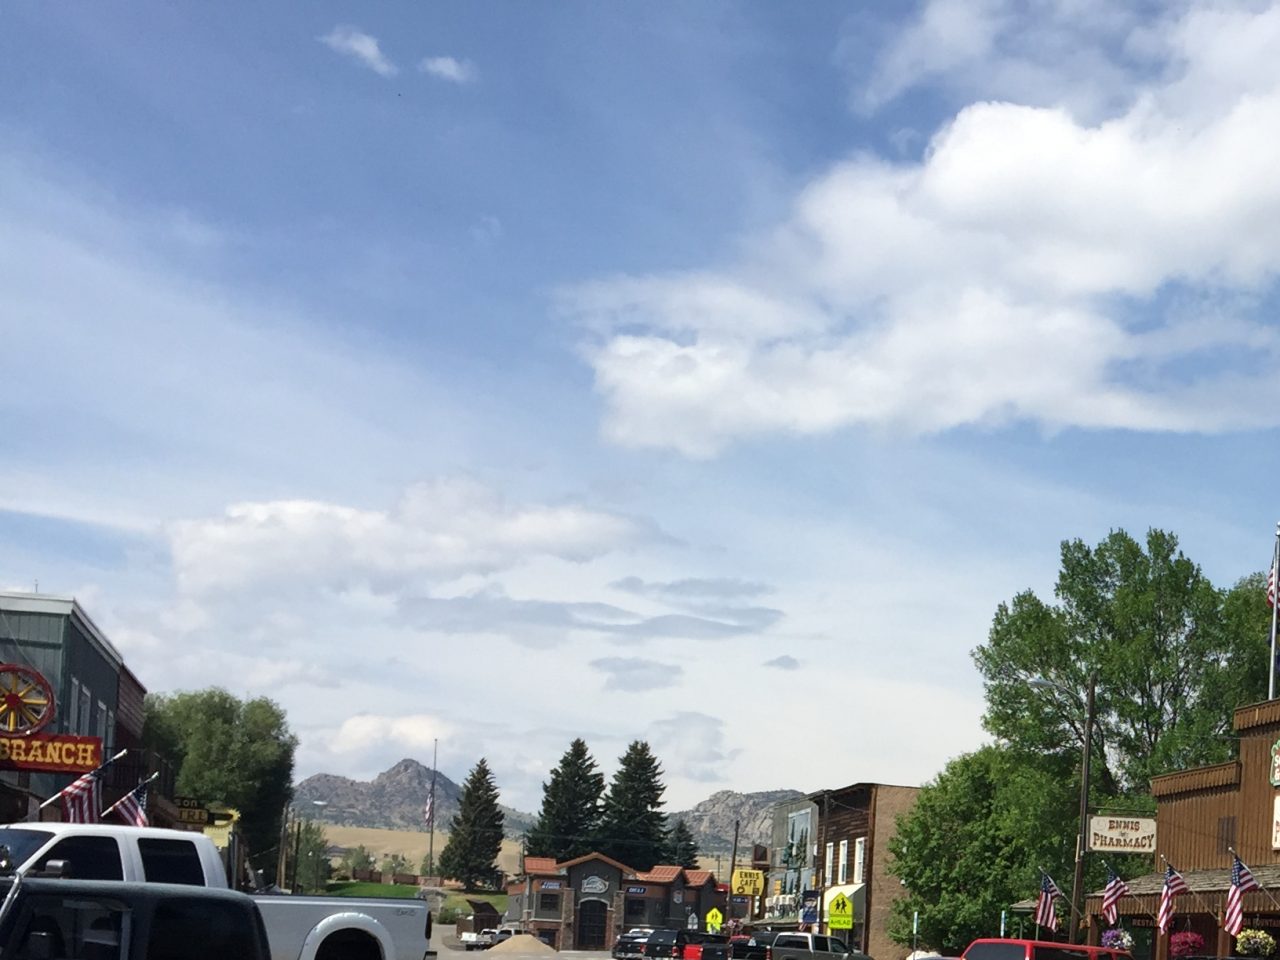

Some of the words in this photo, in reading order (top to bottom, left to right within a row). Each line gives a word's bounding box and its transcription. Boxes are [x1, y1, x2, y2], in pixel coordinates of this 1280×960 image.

[0, 738, 95, 765] BRANCH
[1274, 768, 1280, 780] &
[1108, 820, 1140, 831] ENNIS
[1093, 832, 1155, 848] PHARMACY
[740, 871, 759, 880] ENNIS
[740, 879, 757, 887] CAFE
